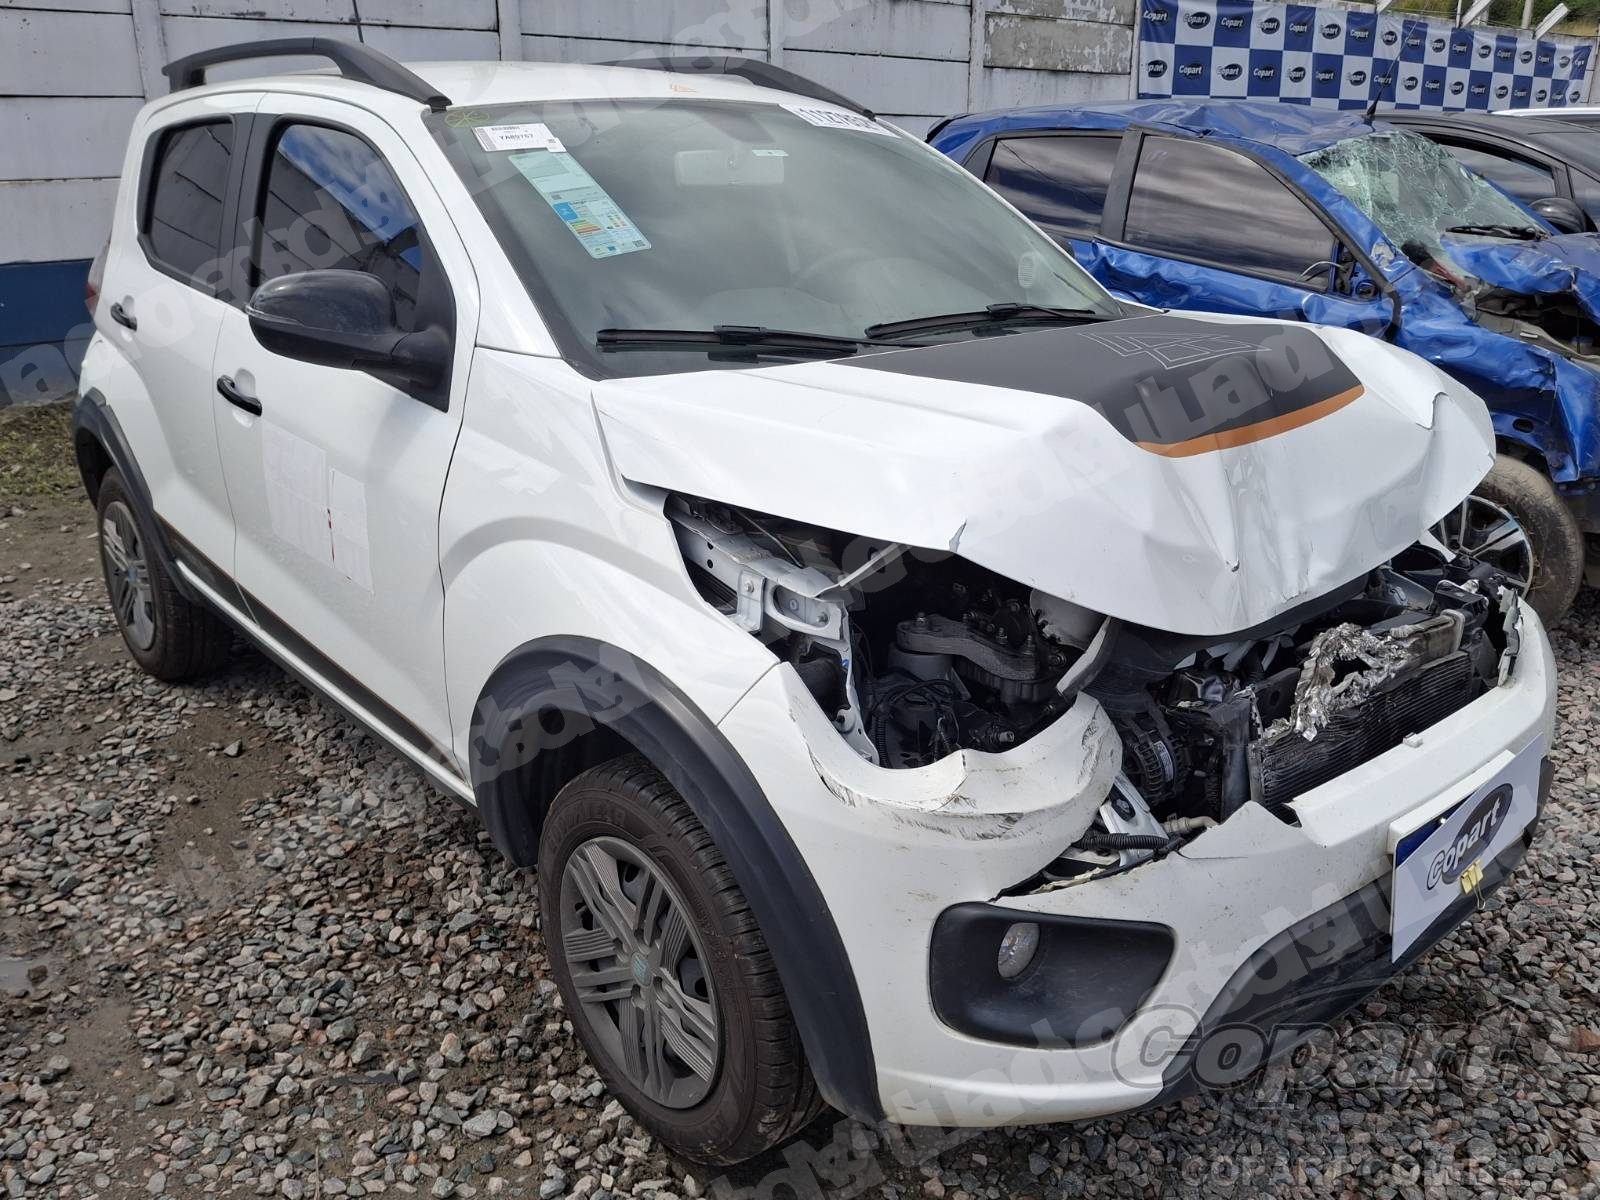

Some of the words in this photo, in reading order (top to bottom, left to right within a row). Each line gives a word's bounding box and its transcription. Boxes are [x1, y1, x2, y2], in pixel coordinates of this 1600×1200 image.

[1143, 10, 1168, 22] Copart
[1221, 17, 1244, 29] Copart
[1289, 23, 1308, 34] Copart
[1350, 29, 1370, 40] Copart
[1179, 65, 1202, 77] Copart
[1253, 67, 1274, 79] Copart
[1427, 796, 1501, 891] Copart
